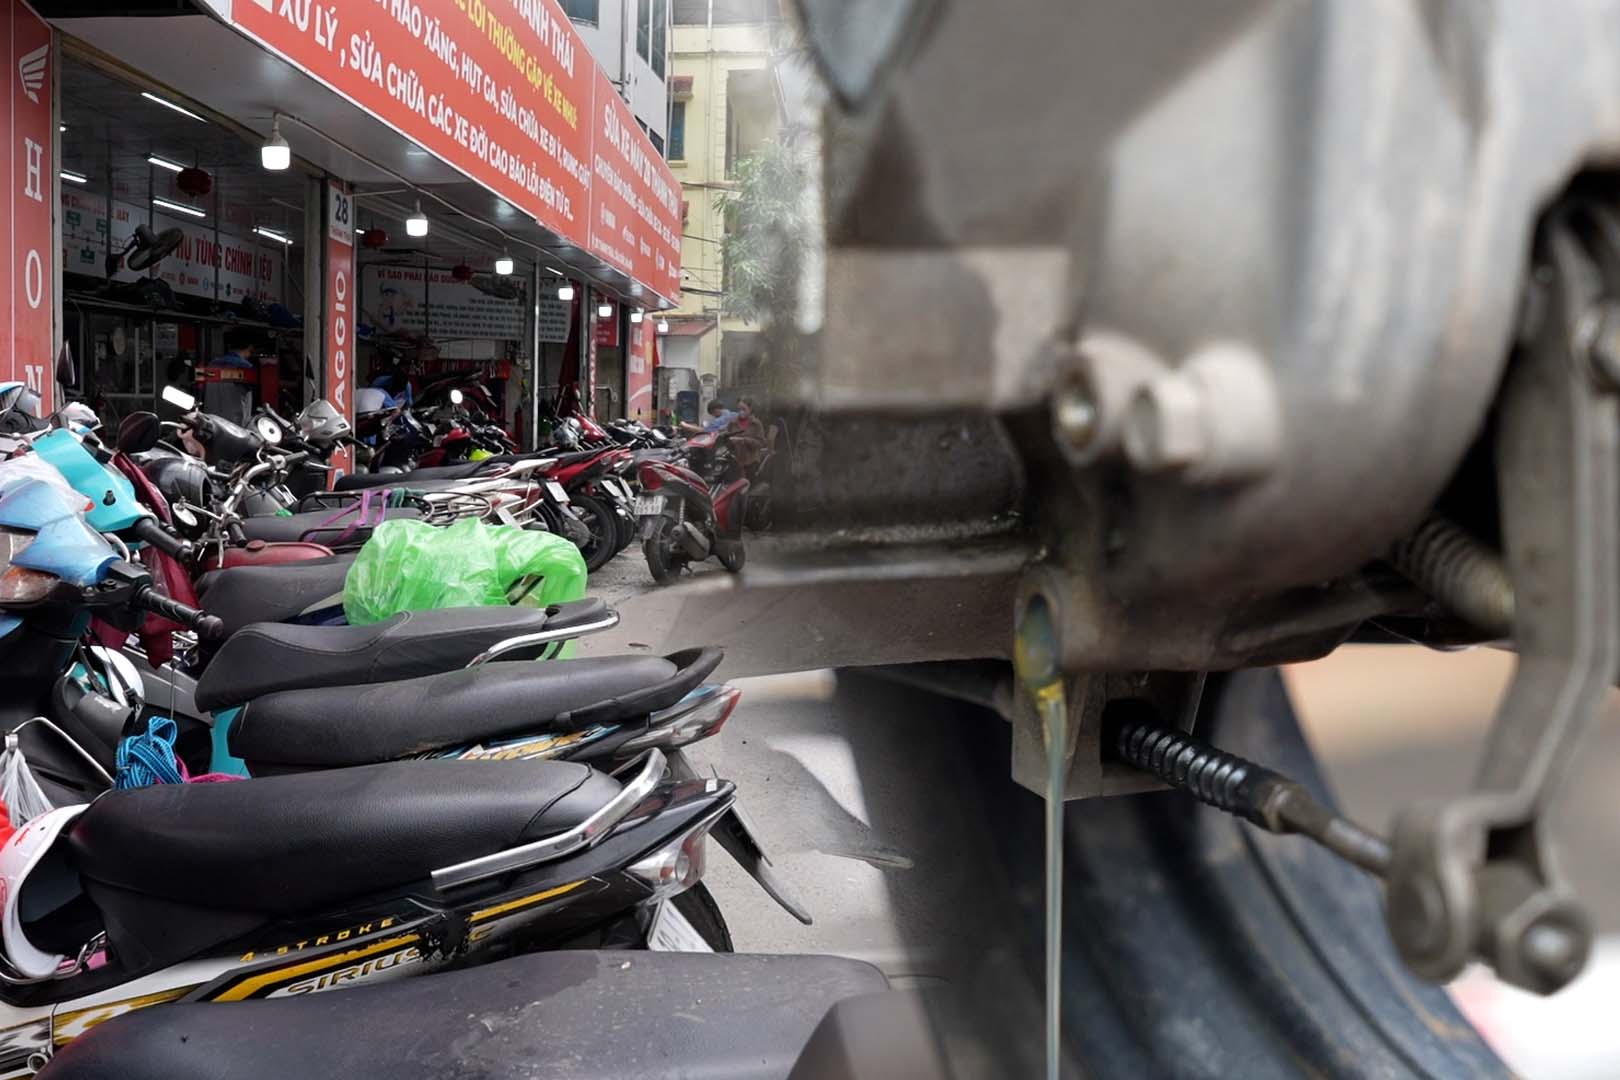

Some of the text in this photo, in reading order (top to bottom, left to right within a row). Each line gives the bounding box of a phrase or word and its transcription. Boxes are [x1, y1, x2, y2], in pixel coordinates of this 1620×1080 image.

[315, 4, 339, 52] LÝ
[350, 29, 384, 88] SỬA
[386, 61, 426, 118] CHỮA
[428, 92, 453, 136] CÁC
[453, 111, 469, 148] XE
[489, 141, 508, 175] CAO
[508, 153, 526, 187] BÁO
[335, 193, 349, 225] 28
[176, 235, 192, 267] HỤ
[225, 244, 252, 276] CHÍNH
[335, 271, 346, 456] AGGIO
[240, 916, 395, 963] 4 STROKE
